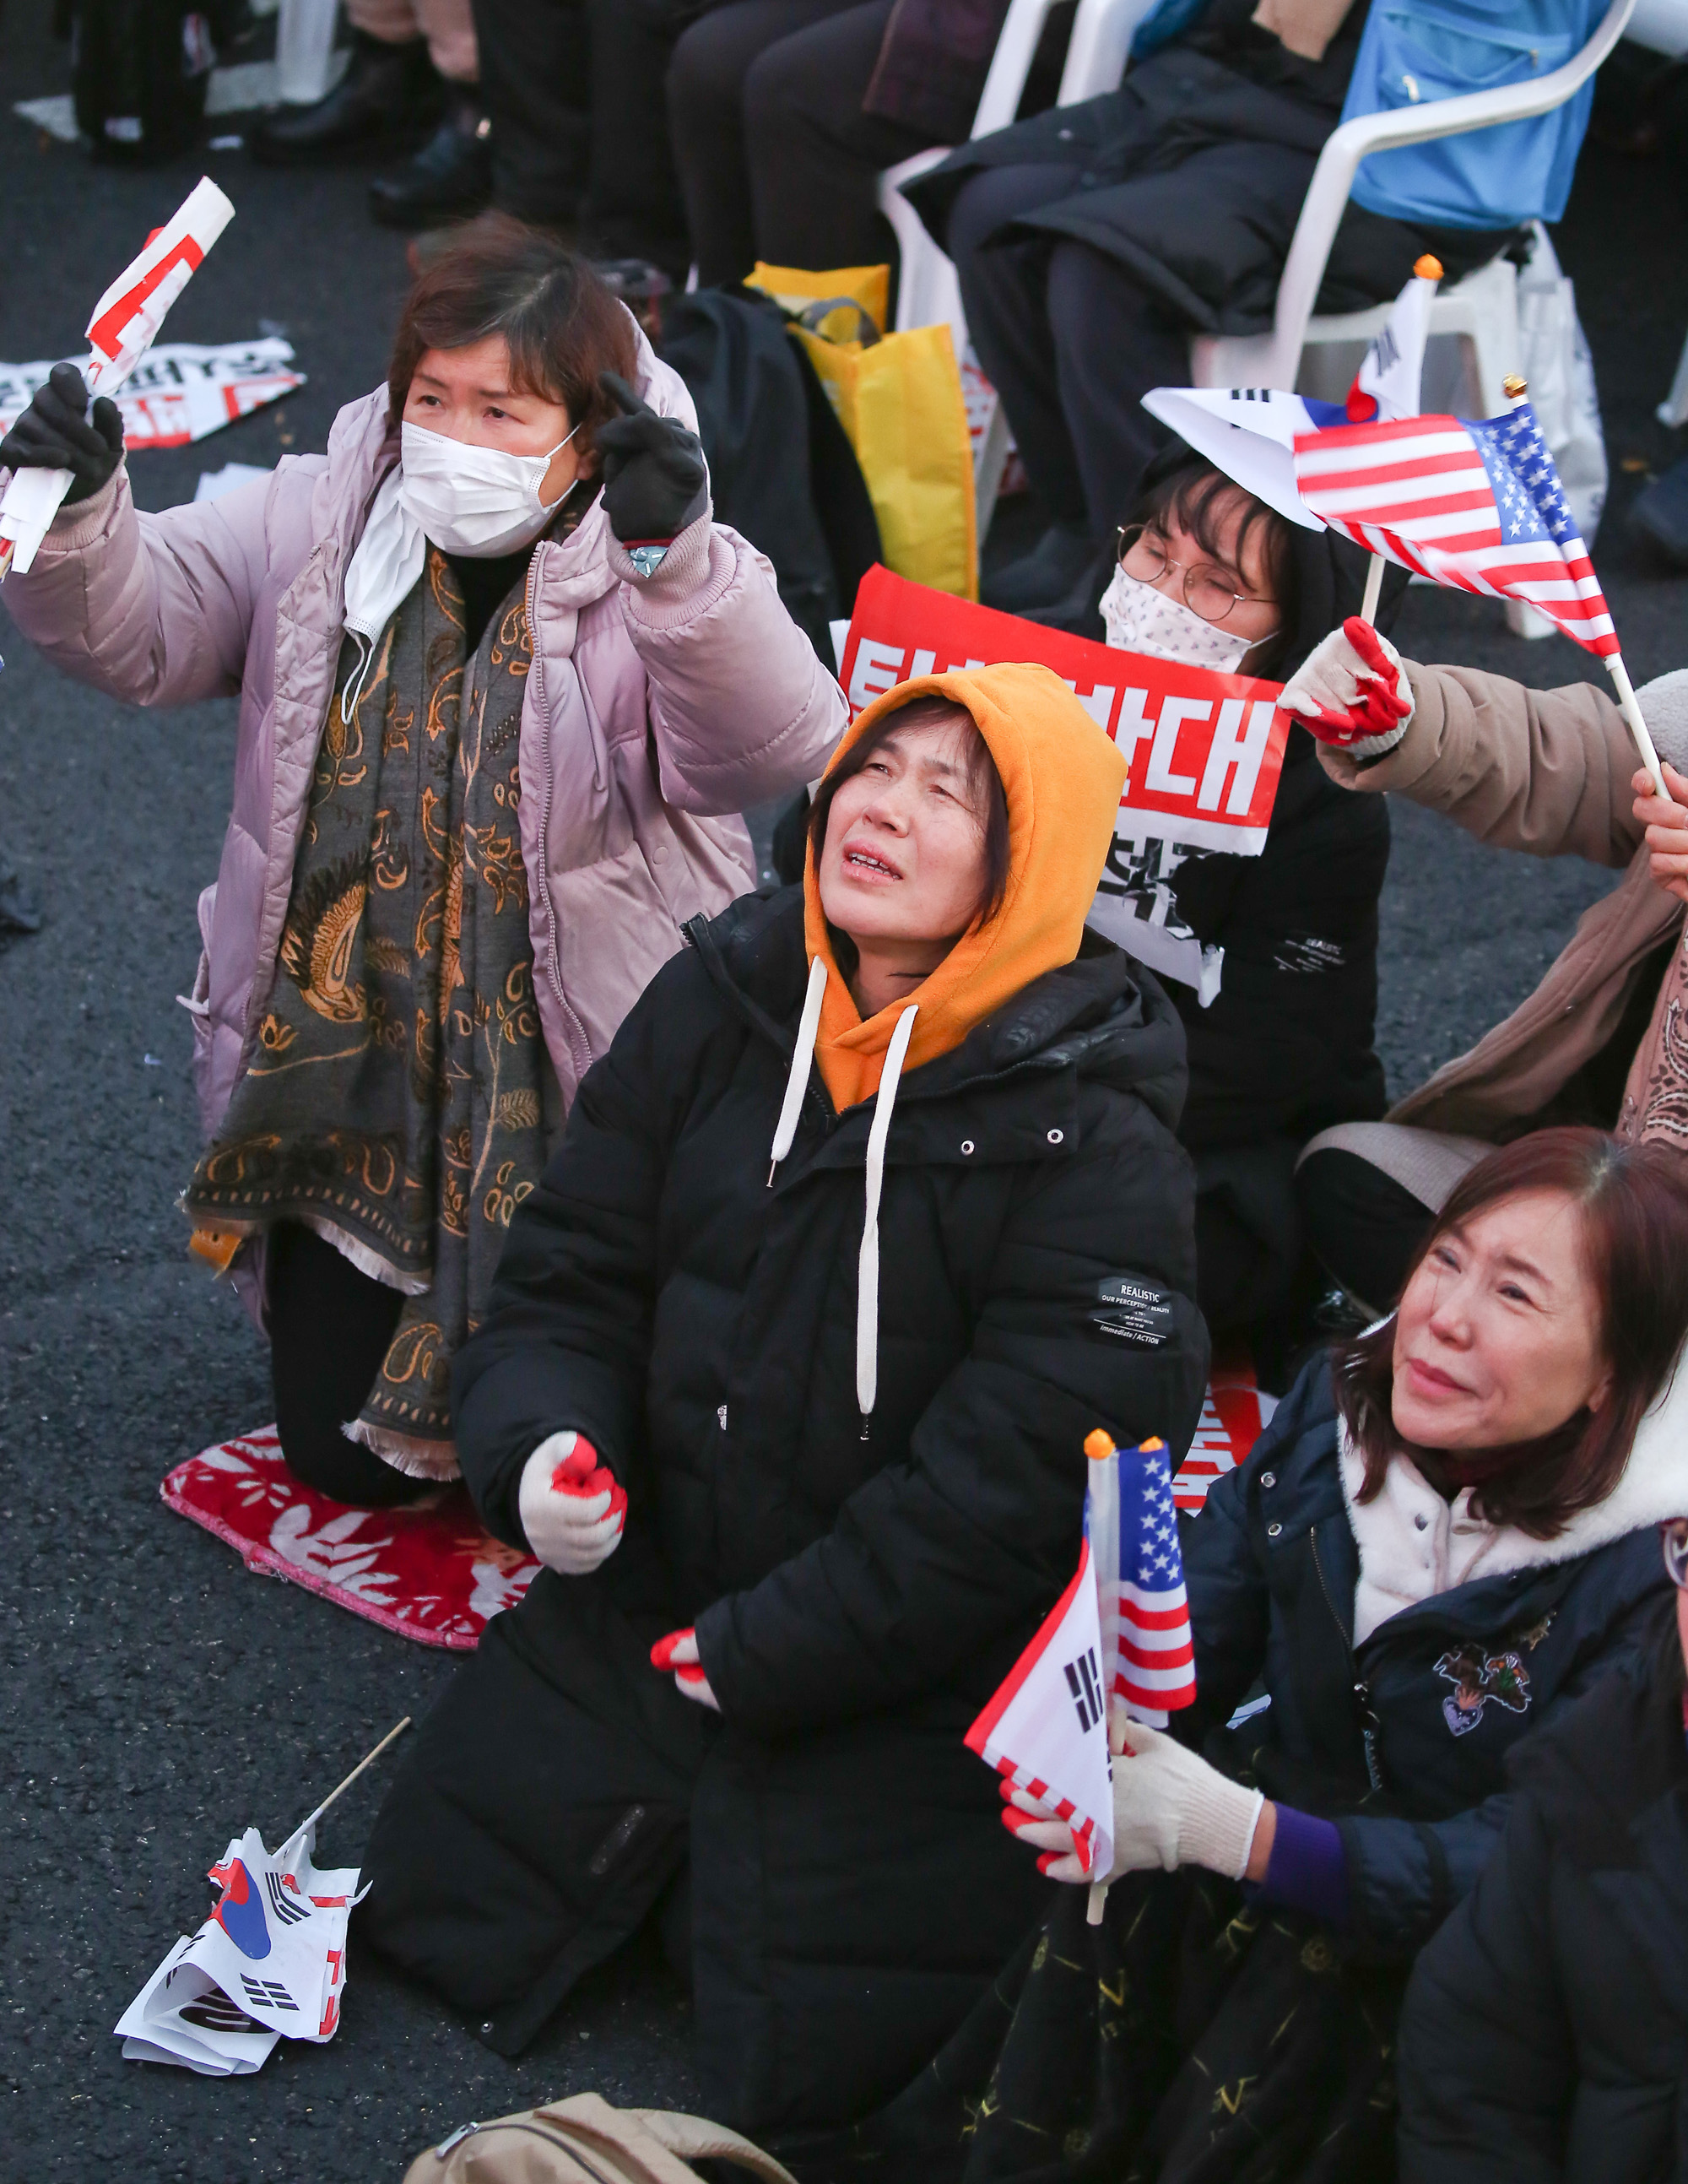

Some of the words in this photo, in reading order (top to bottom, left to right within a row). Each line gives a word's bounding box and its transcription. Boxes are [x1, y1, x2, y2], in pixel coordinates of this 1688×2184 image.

[1101, 1294, 1115, 1303] OUR
[1121, 1284, 1160, 1303] REALISTIC
[1100, 1325, 1133, 1338] immediate
[1137, 1333, 1160, 1345] ACTION
